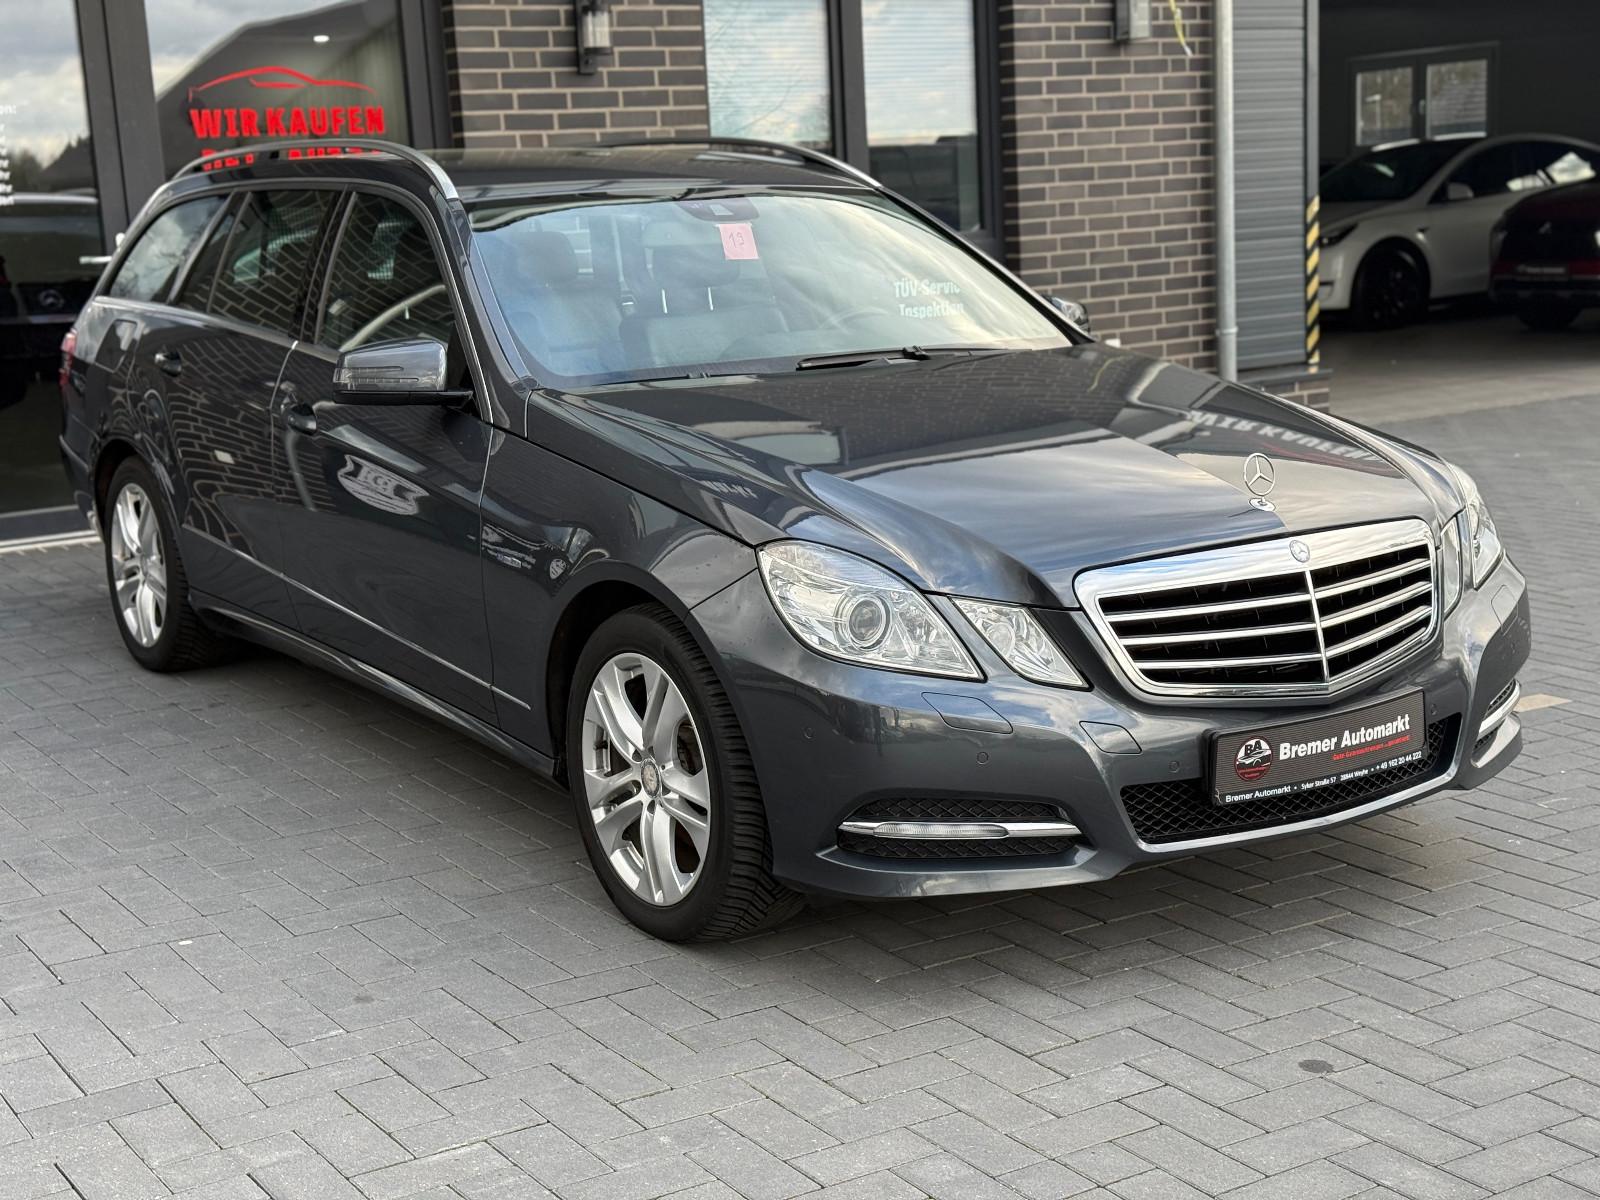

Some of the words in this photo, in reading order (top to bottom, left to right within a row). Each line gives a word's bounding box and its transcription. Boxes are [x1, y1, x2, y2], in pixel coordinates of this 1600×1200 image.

[190, 107, 260, 139] WIR
[265, 104, 386, 137] KAUFEN
[1244, 739, 1263, 757] BA
[1279, 736, 1338, 760] Bremer
[1340, 713, 1410, 748] Automarkt
[1225, 791, 1254, 803] Bremer
[1253, 784, 1292, 799] Automarkt
[1406, 753, 1412, 762] 44
